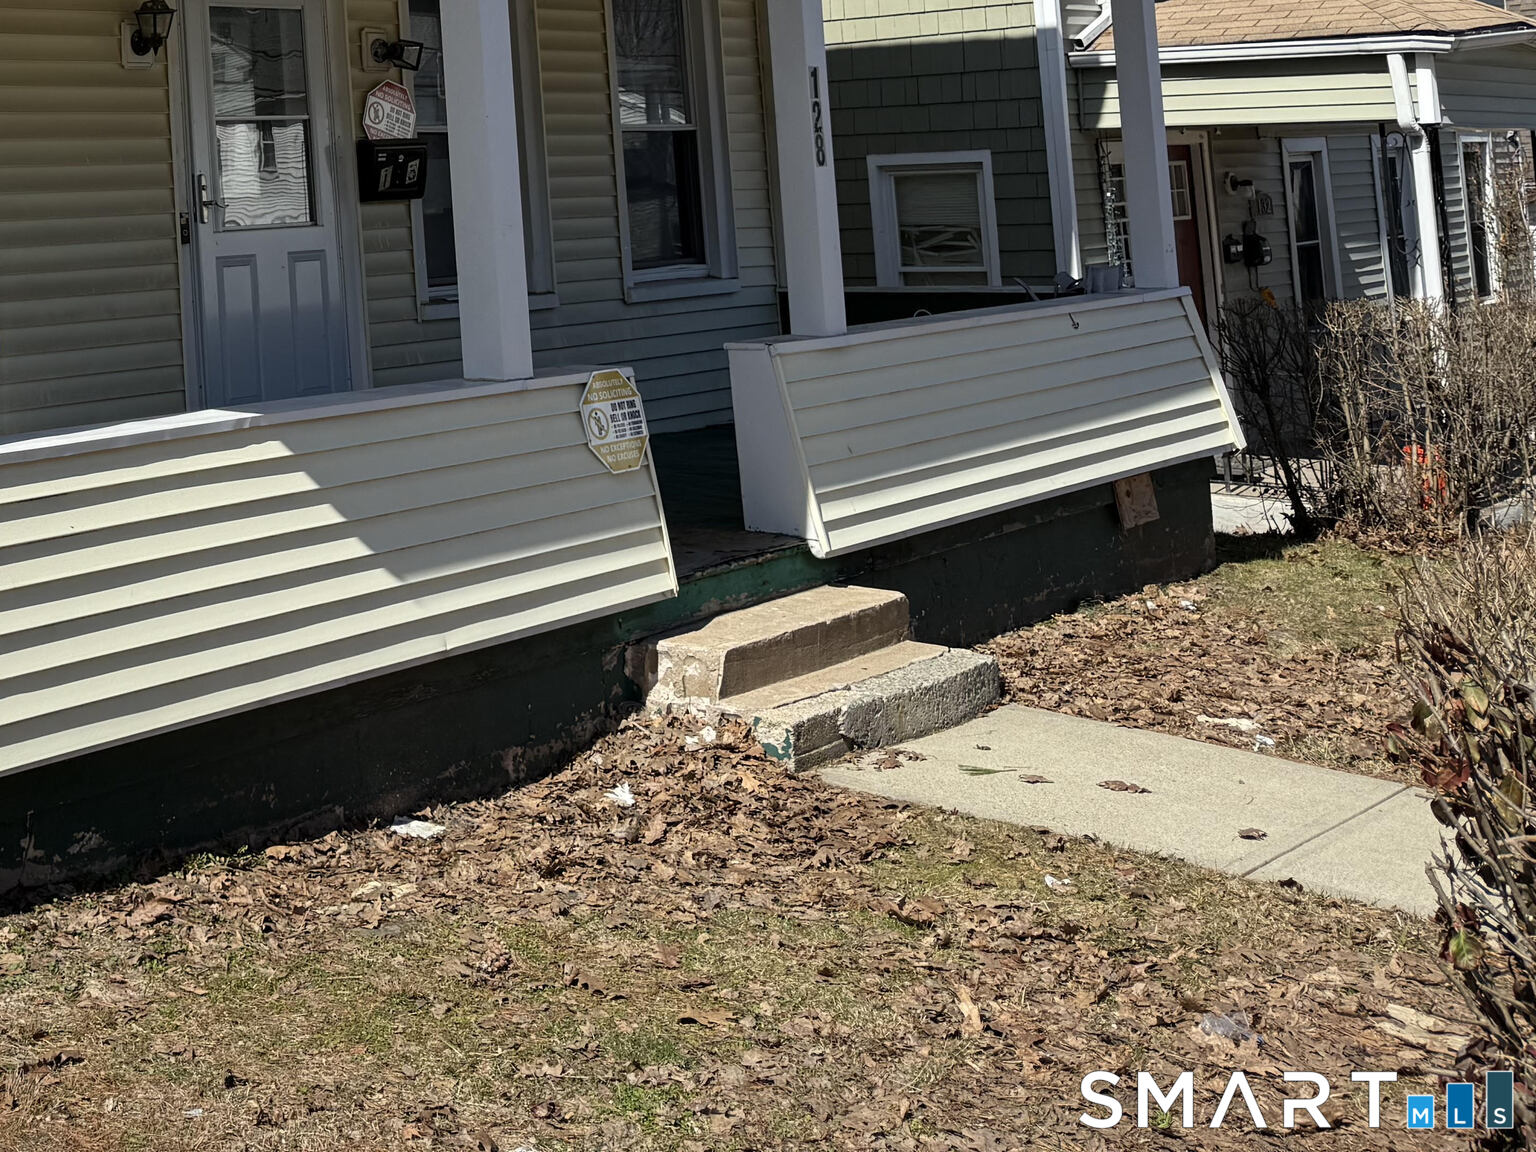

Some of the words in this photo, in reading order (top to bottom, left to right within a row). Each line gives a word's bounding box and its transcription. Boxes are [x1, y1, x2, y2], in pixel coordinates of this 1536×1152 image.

[811, 66, 826, 167] 128
[592, 379, 623, 389] ABSOLUTELY
[587, 393, 598, 401] NO
[599, 387, 632, 400] SOLICITING
[617, 401, 626, 411] NOT
